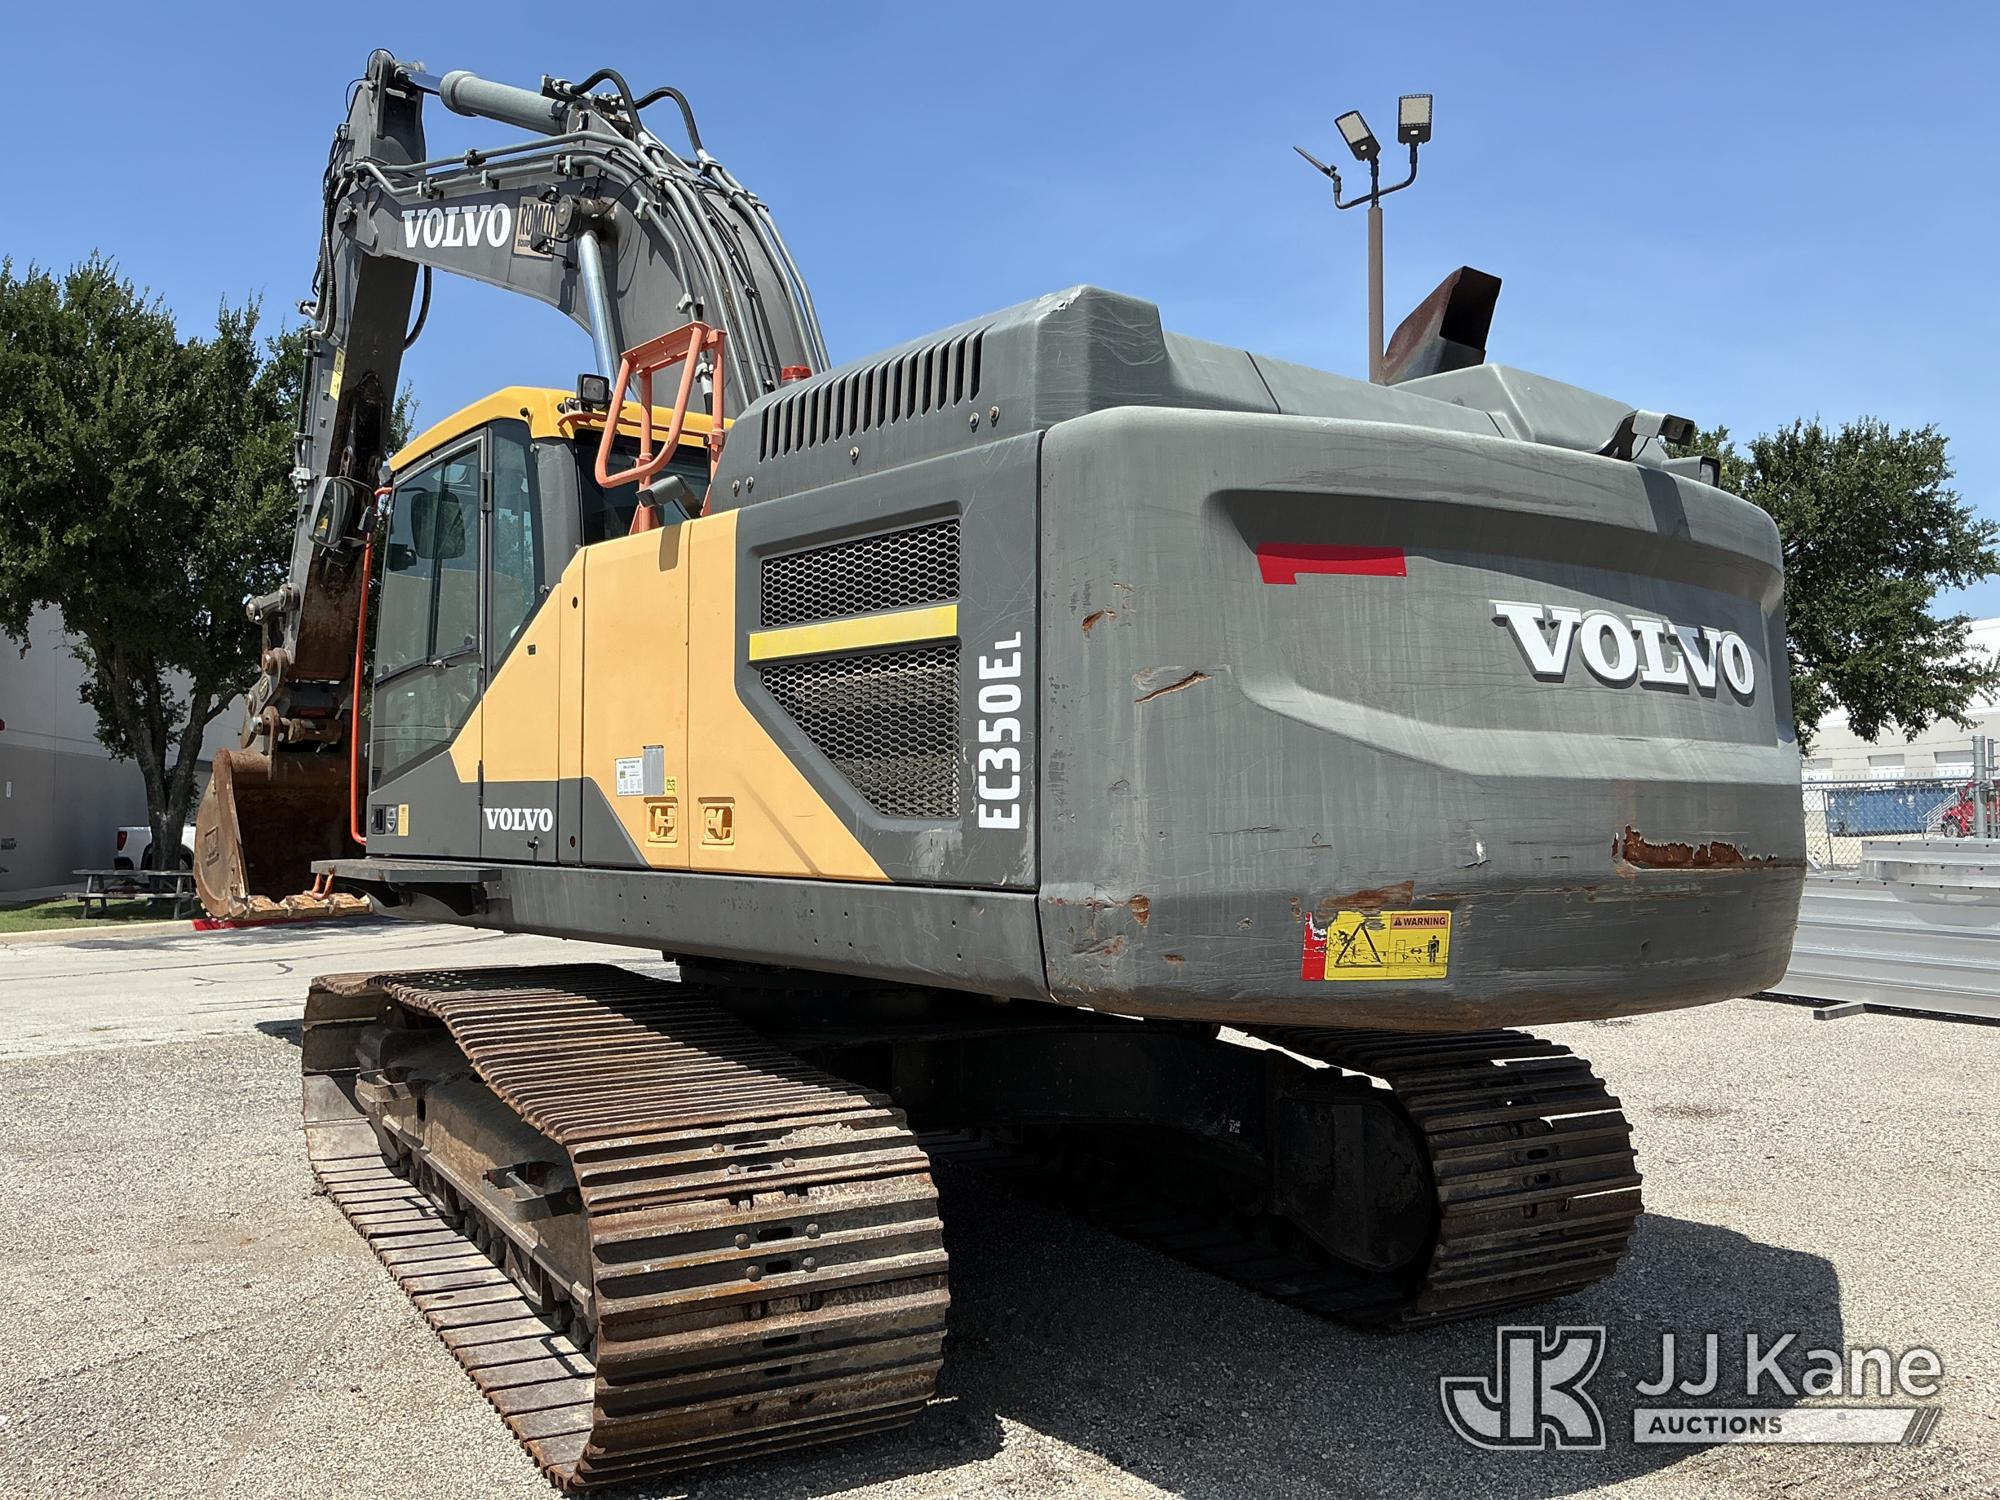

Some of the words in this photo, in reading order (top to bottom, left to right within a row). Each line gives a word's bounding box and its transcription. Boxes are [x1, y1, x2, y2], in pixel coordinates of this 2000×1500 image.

[401, 203, 512, 249] VOLVO
[1491, 601, 1756, 702] VOLVO
[483, 807, 554, 832] VOLVO
[1403, 916, 1446, 927] WARNING
